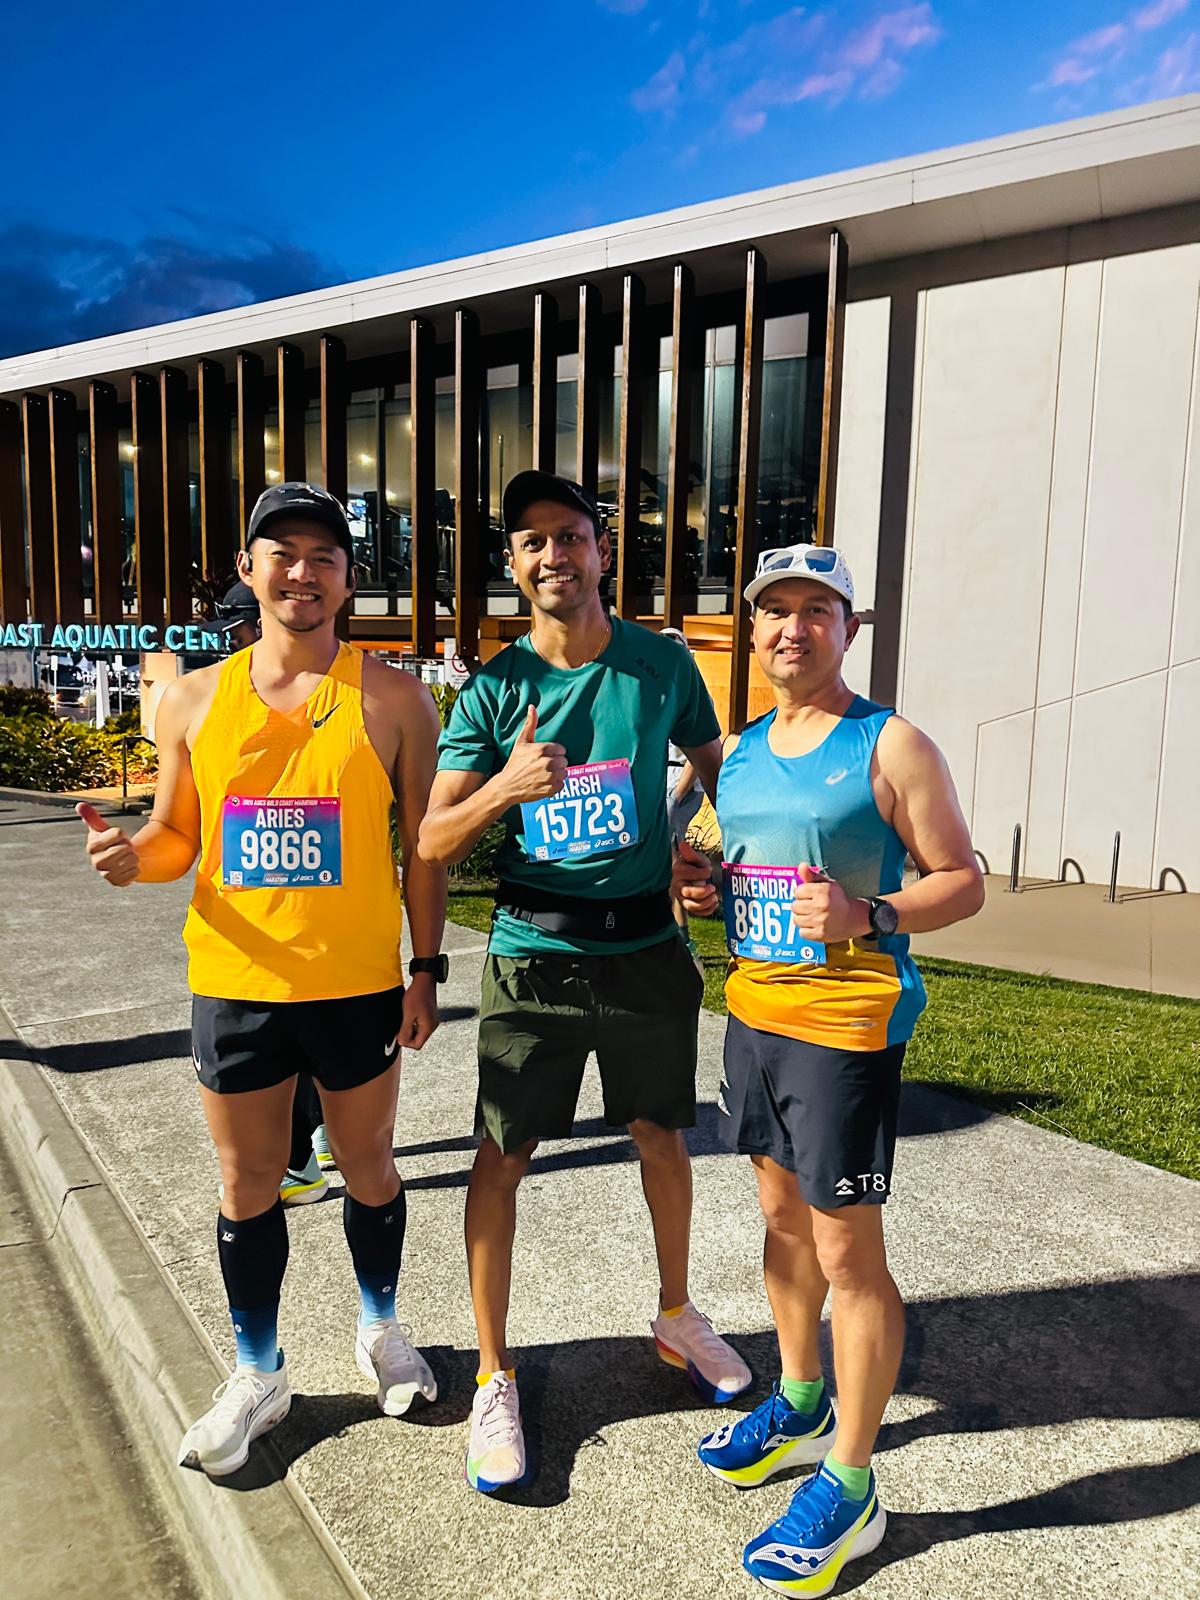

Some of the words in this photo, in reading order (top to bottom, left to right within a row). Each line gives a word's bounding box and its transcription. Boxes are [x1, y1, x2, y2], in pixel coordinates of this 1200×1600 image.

[0, 623, 43, 647] AST
[51, 624, 158, 652] AQUATIC
[549, 774, 602, 801] ARSH
[255, 808, 305, 828] ARIES
[534, 793, 626, 844] 15723
[240, 829, 322, 870] 9866
[734, 898, 797, 945] 8967
[857, 1173, 887, 1192] T8
